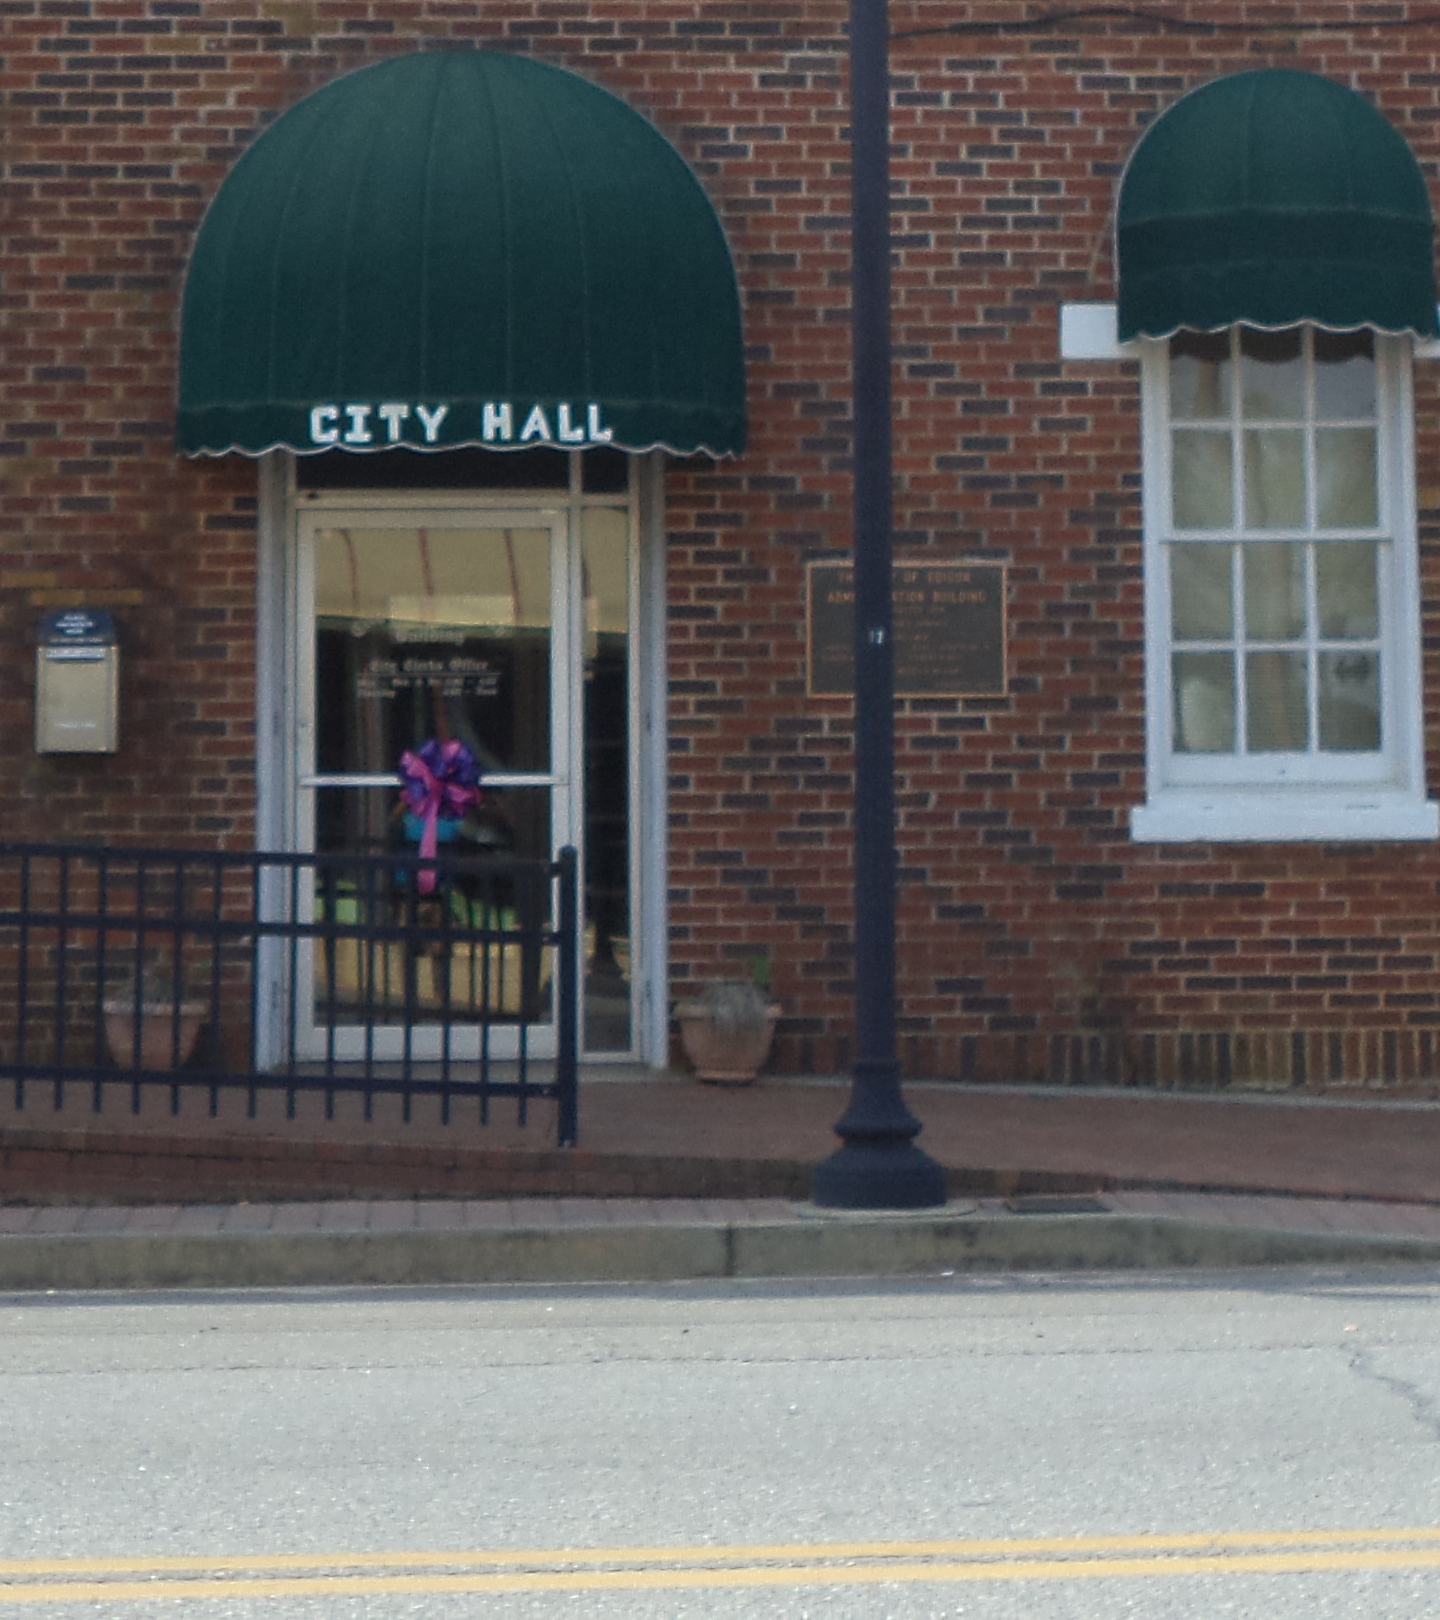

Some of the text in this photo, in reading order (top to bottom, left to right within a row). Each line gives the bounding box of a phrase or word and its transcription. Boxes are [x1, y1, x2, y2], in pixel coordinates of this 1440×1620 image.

[310, 402, 614, 444] CITY HALL
[904, 571, 918, 583] OF
[927, 571, 972, 583] EDISON
[933, 590, 986, 603] BUILDING
